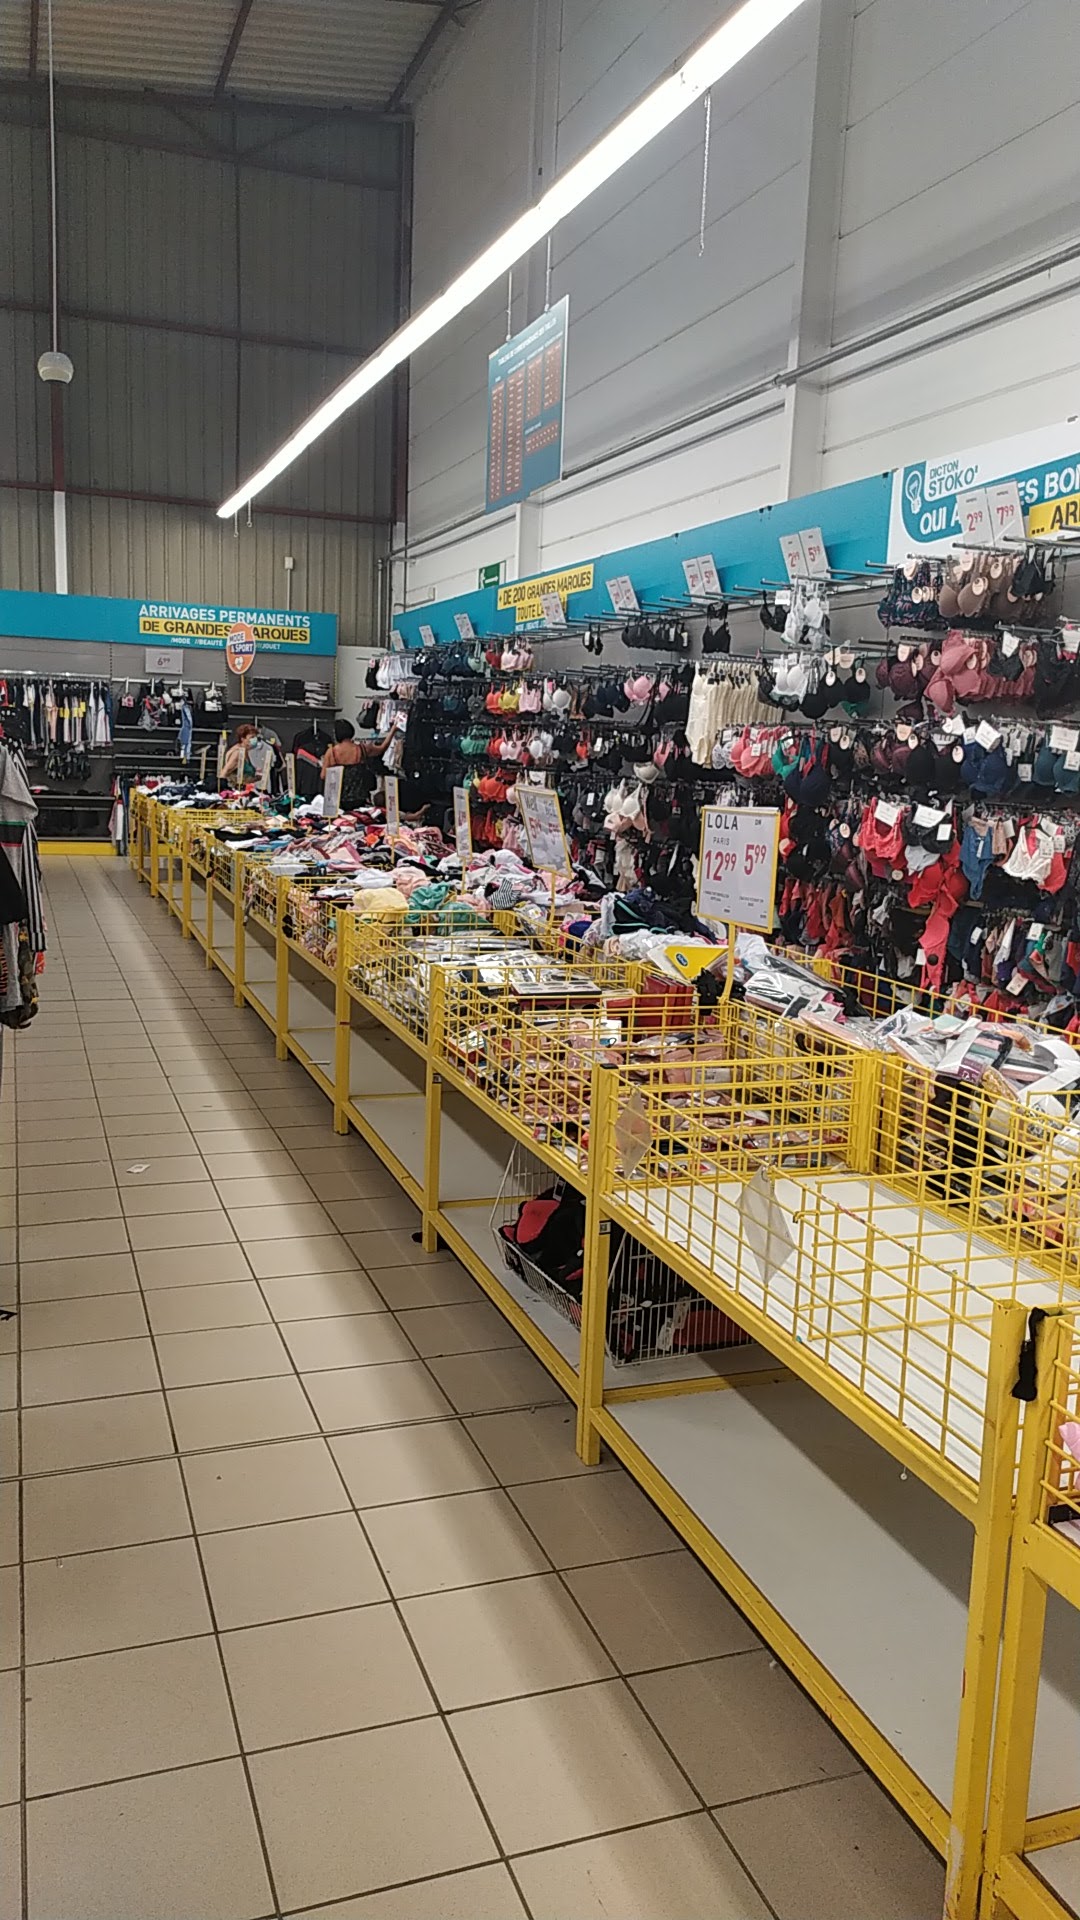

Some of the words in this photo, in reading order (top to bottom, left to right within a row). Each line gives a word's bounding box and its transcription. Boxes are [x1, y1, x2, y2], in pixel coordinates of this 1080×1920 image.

[930, 459, 959, 480] DICTON
[919, 506, 947, 535] QUI
[966, 510, 983, 532] 299
[996, 504, 1015, 526] 799
[1050, 500, 1080, 530] AR
[503, 589, 512, 606] DE
[513, 585, 526, 602] 200
[526, 580, 557, 599] GRANDES
[556, 570, 591, 592] MARQUES
[139, 604, 216, 622] ARRIVAGES
[219, 610, 311, 628] PERMANENTS
[517, 601, 537, 621] TOUTE
[142, 620, 160, 633] DE
[163, 620, 231, 637] GRANDES
[253, 627, 308, 642] ARQUES
[229, 633, 245, 642] MODE
[235, 643, 254, 653] SPORT
[707, 813, 739, 831] LOLA
[713, 836, 730, 846] PARIS
[705, 849, 737, 881] 1299
[744, 844, 767, 875] 599
